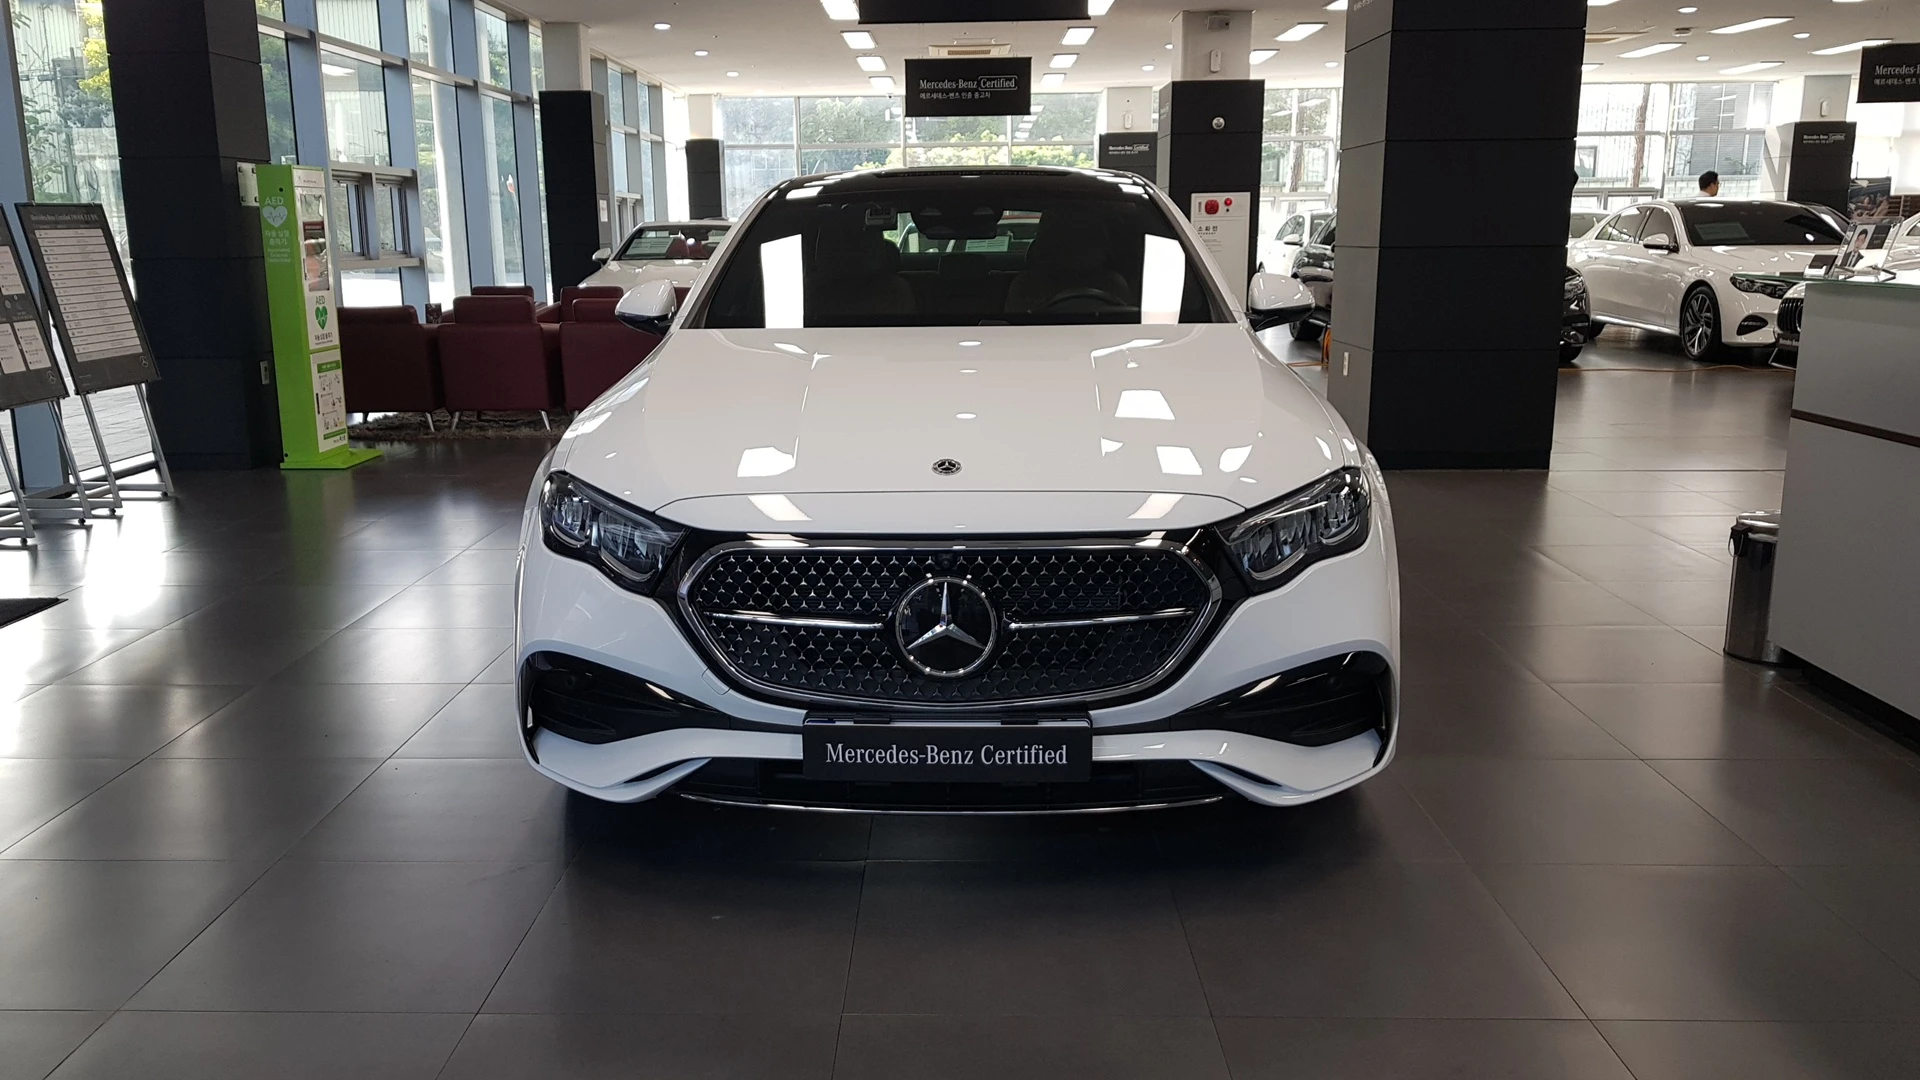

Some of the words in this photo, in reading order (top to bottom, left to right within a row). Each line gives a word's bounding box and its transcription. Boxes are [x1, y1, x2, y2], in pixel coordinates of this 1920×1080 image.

[919, 78, 977, 89] Mercedes-Benz
[980, 78, 1015, 88] Certified
[264, 196, 284, 205] AED
[315, 295, 326, 305] AED
[825, 743, 974, 765] Mercedes-Benz
[980, 745, 1068, 765] Certified
